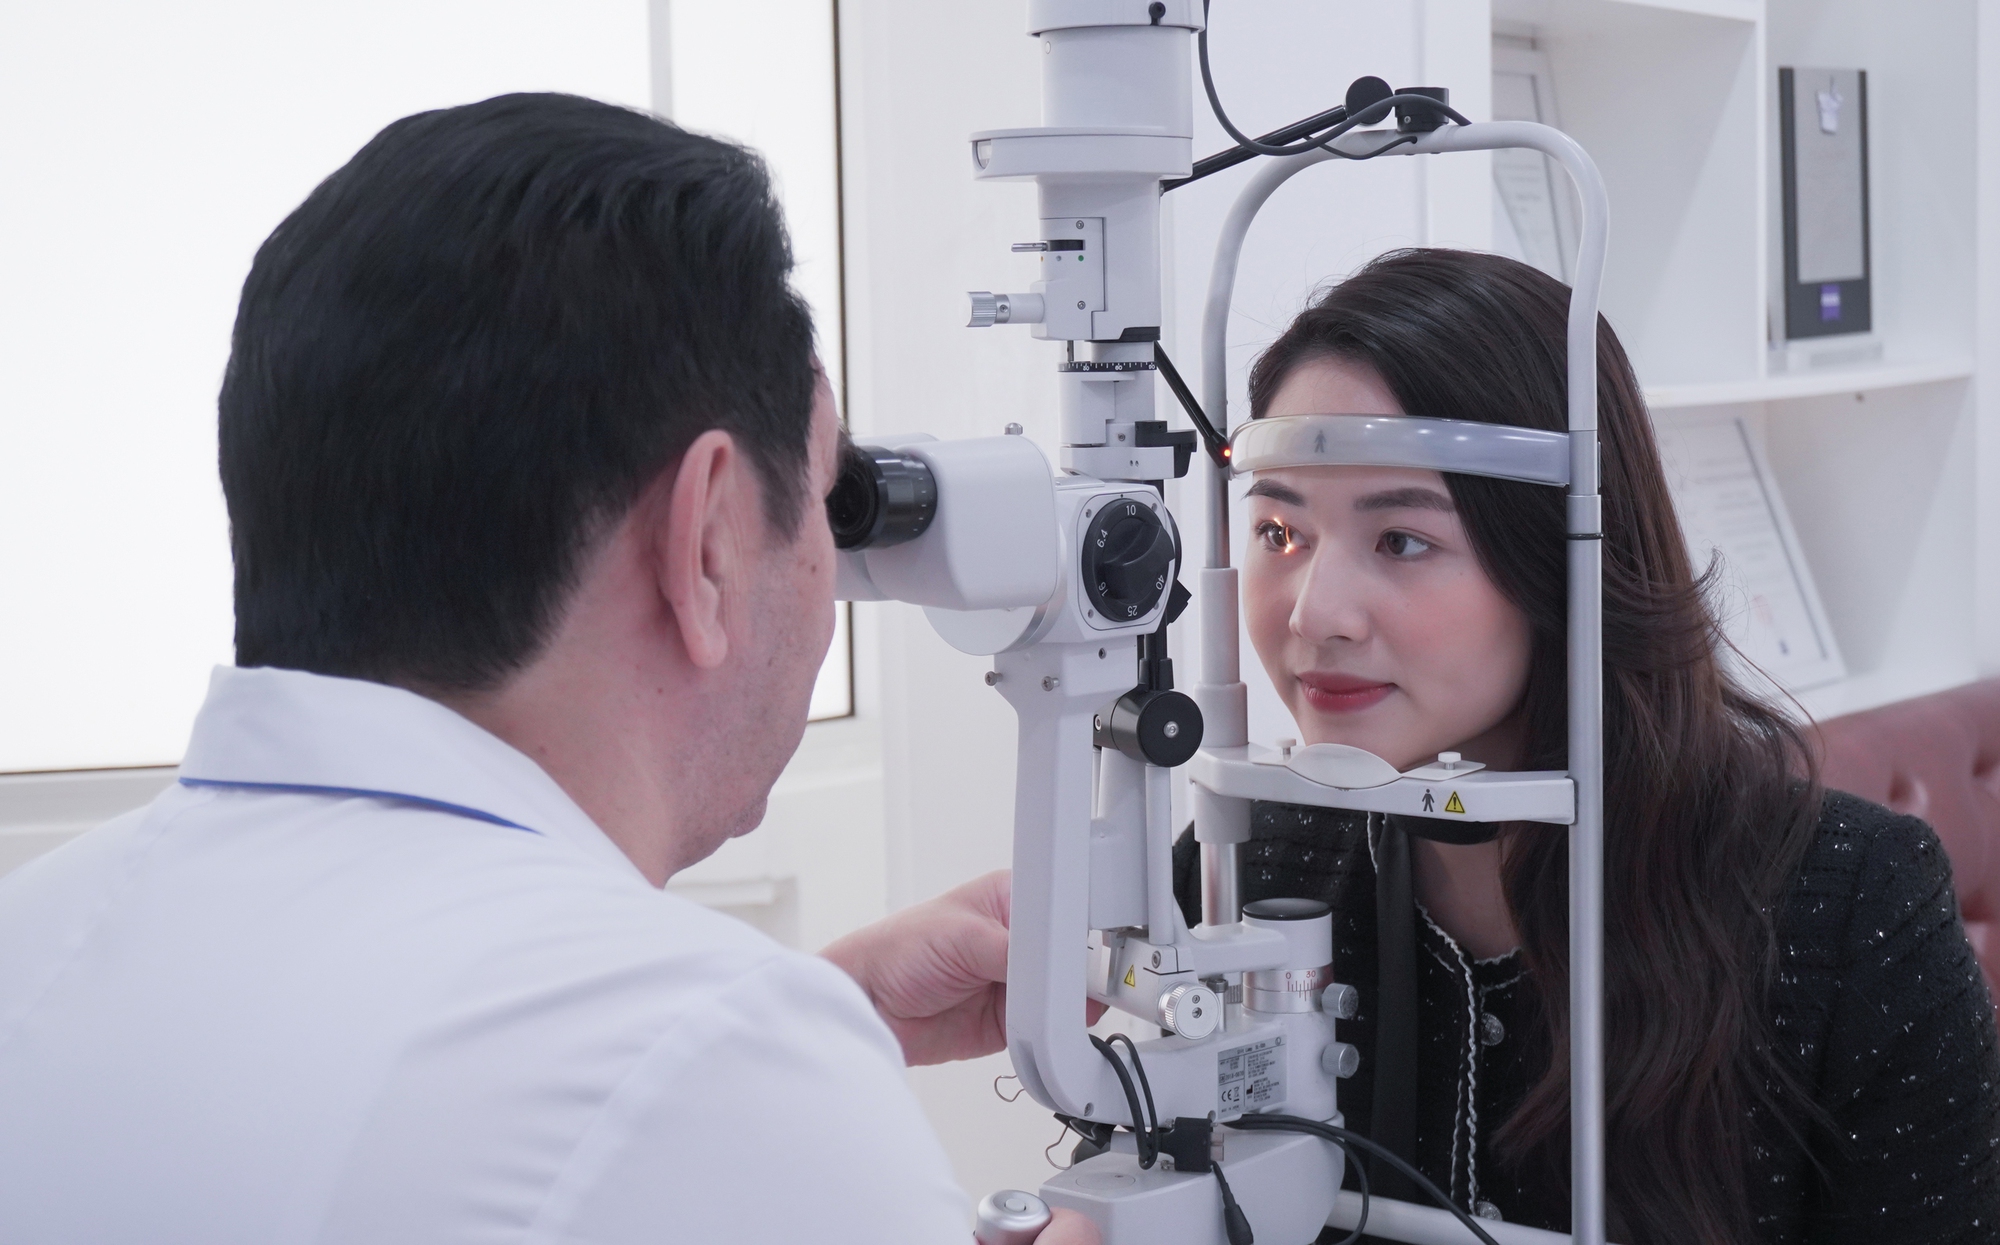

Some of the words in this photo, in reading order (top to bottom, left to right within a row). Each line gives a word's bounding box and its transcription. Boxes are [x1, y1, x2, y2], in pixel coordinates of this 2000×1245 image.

[1126, 504, 1137, 516] 10
[1096, 529, 1108, 548] 6.4
[1155, 574, 1165, 590] 40
[1098, 581, 1109, 597] 16
[1127, 605, 1138, 617] 25
[1306, 970, 1316, 978] 30
[1221, 1089, 1233, 1102] CE
